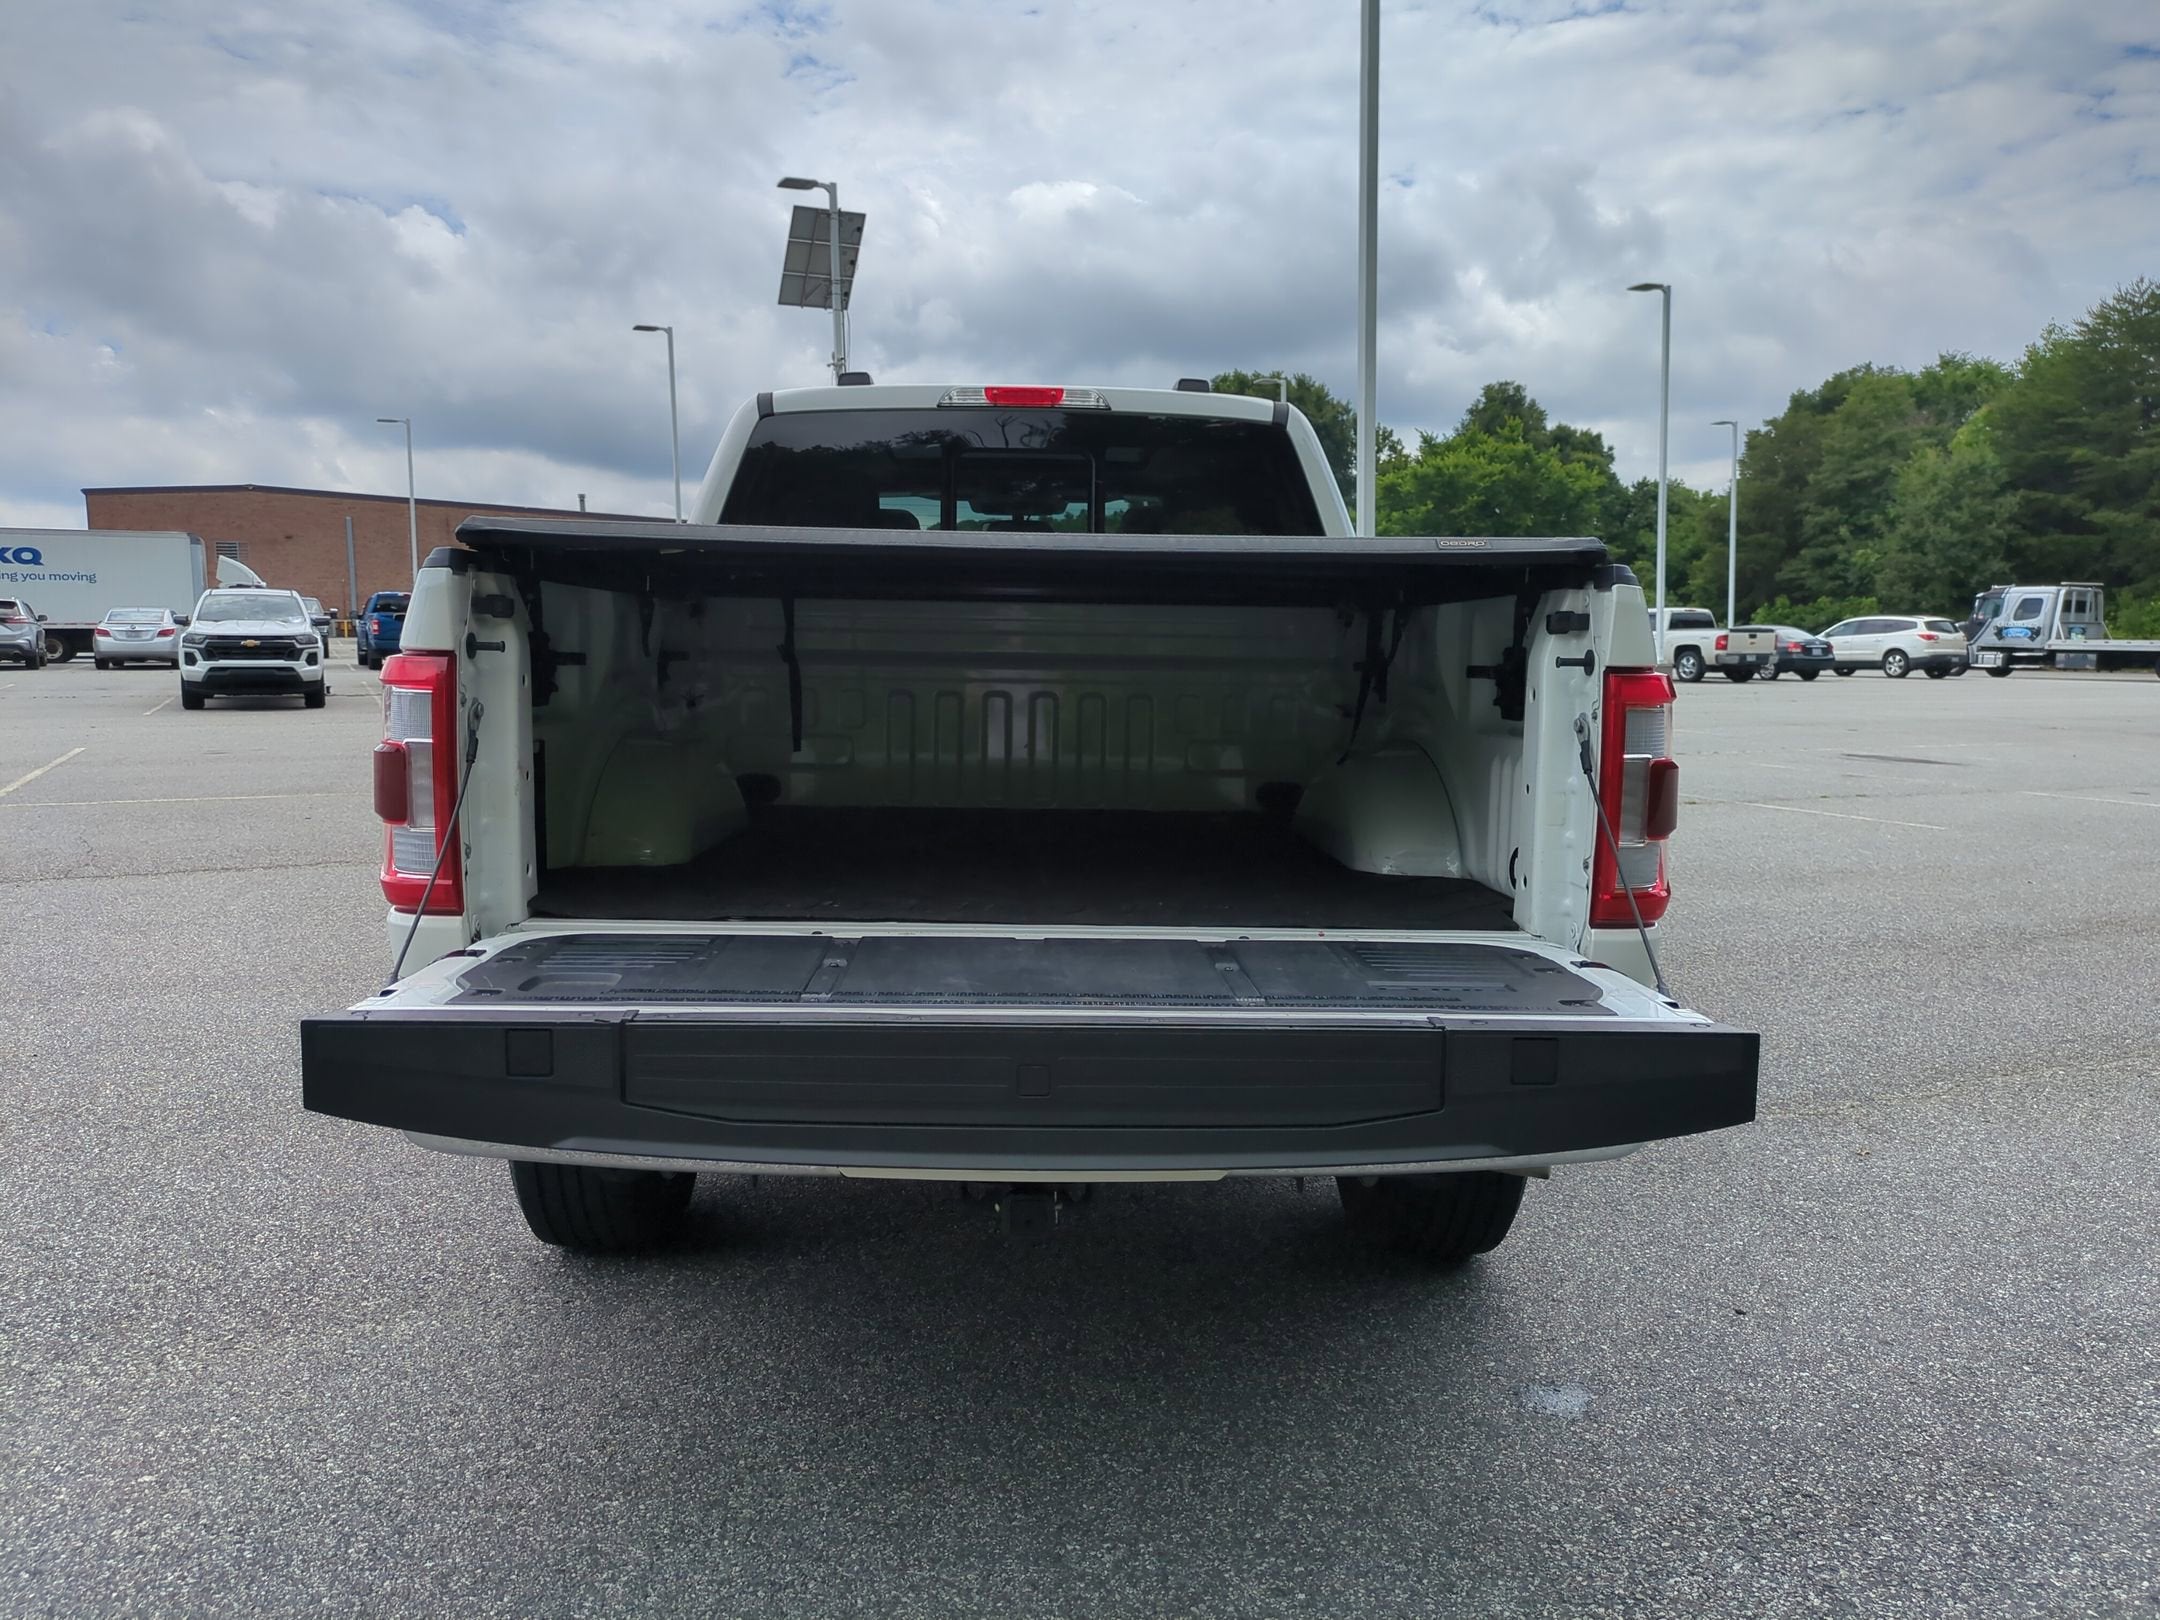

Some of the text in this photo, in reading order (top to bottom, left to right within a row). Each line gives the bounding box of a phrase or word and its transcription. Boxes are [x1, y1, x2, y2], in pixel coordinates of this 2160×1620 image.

[0, 571, 97, 584] ng you moving
